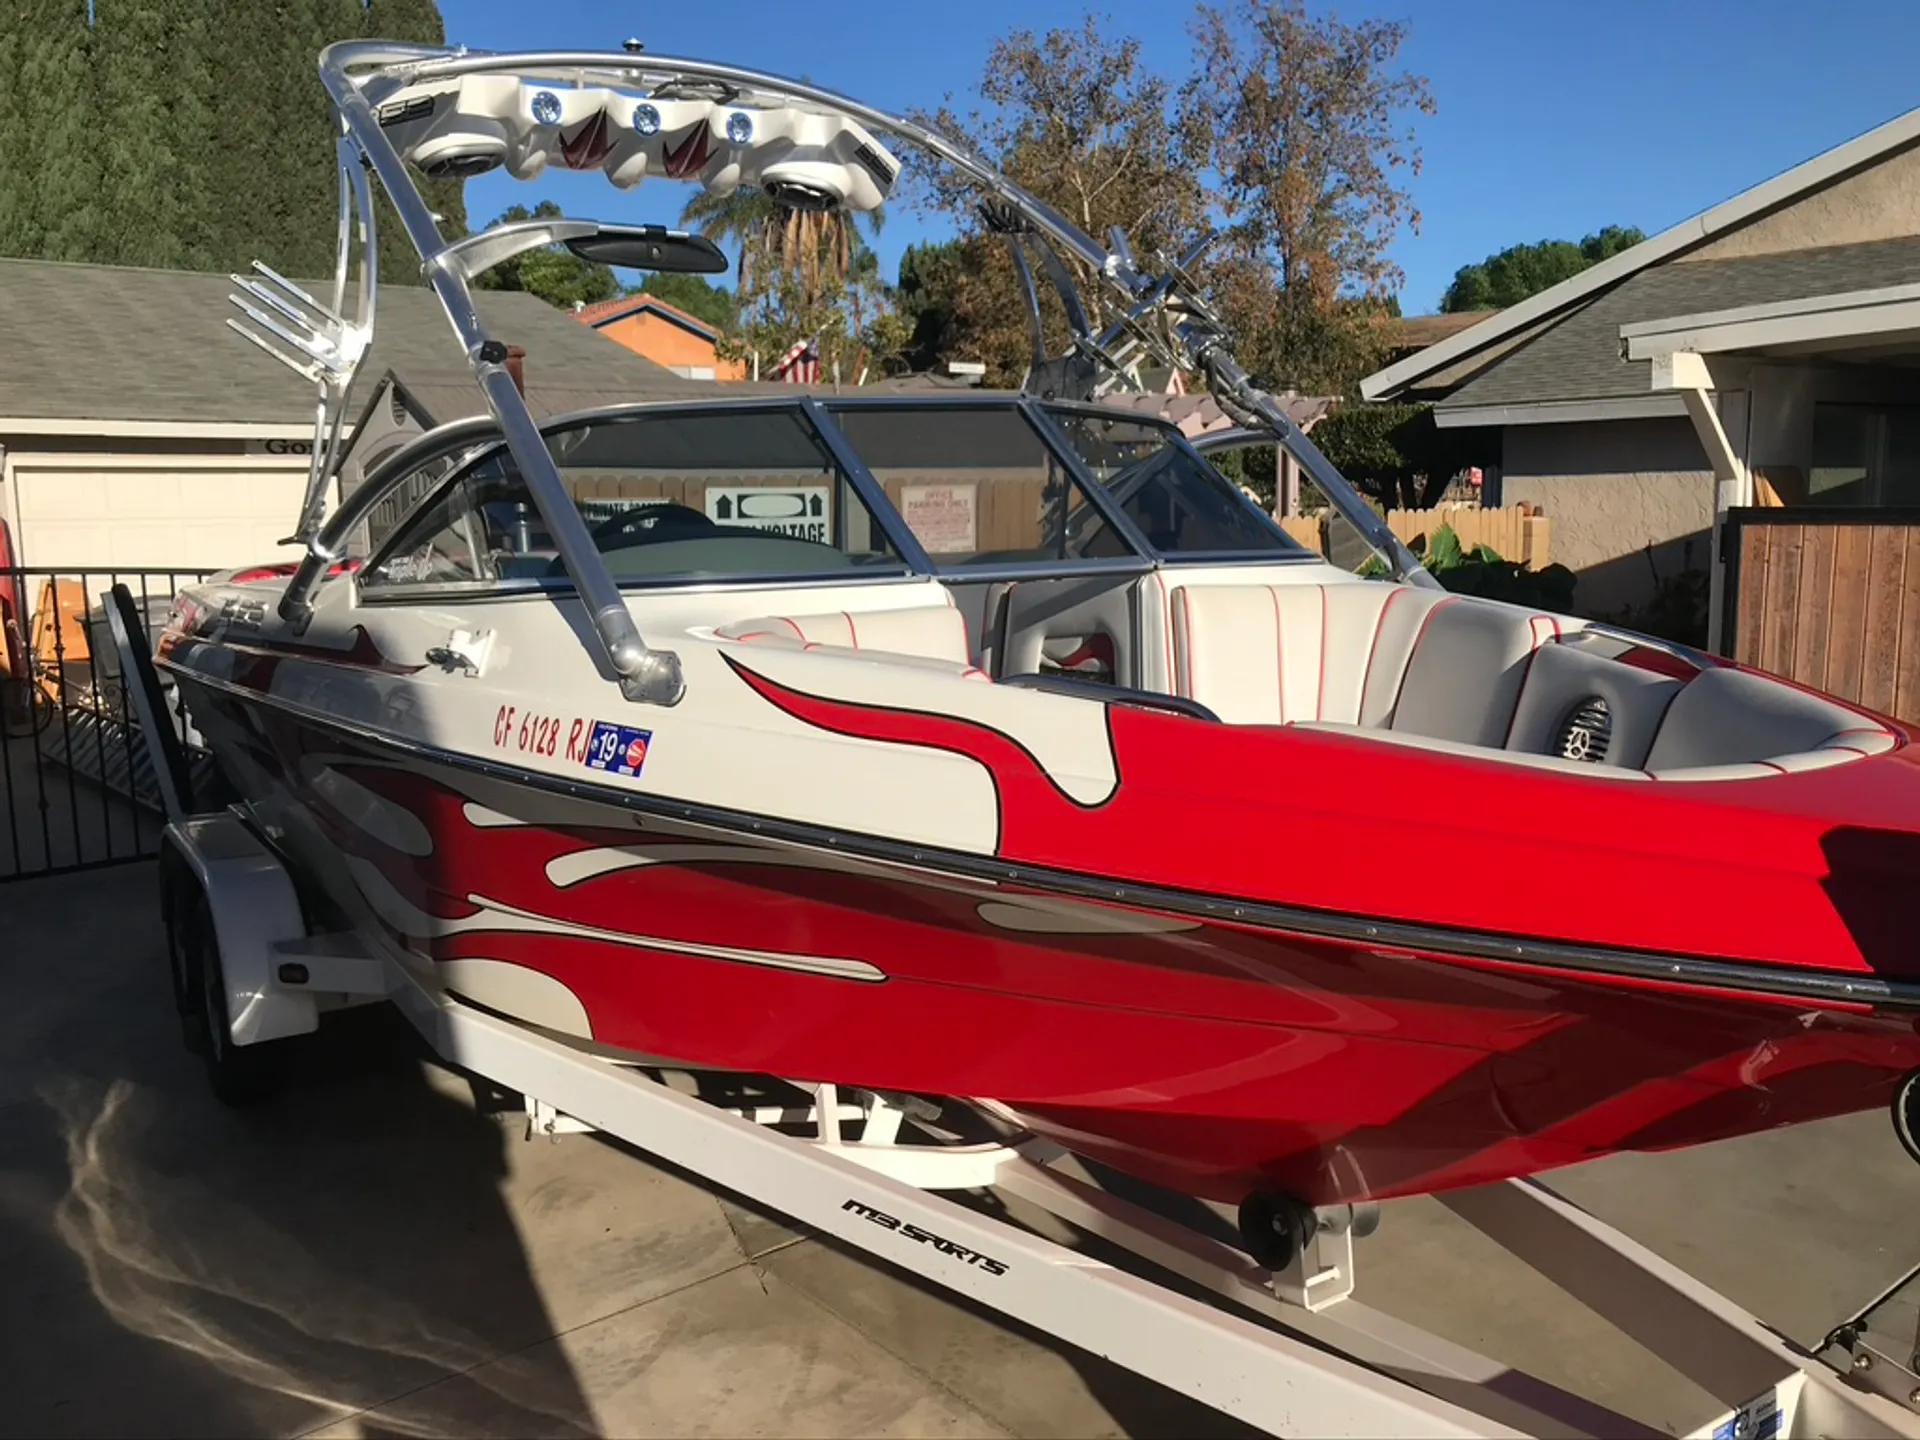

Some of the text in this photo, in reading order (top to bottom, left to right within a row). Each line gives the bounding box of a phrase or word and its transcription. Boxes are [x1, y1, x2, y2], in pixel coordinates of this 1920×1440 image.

[493, 704, 516, 748] CF
[519, 711, 561, 757] 6128
[598, 731, 618, 762] 19
[898, 1222, 1010, 1277] SPORTS
